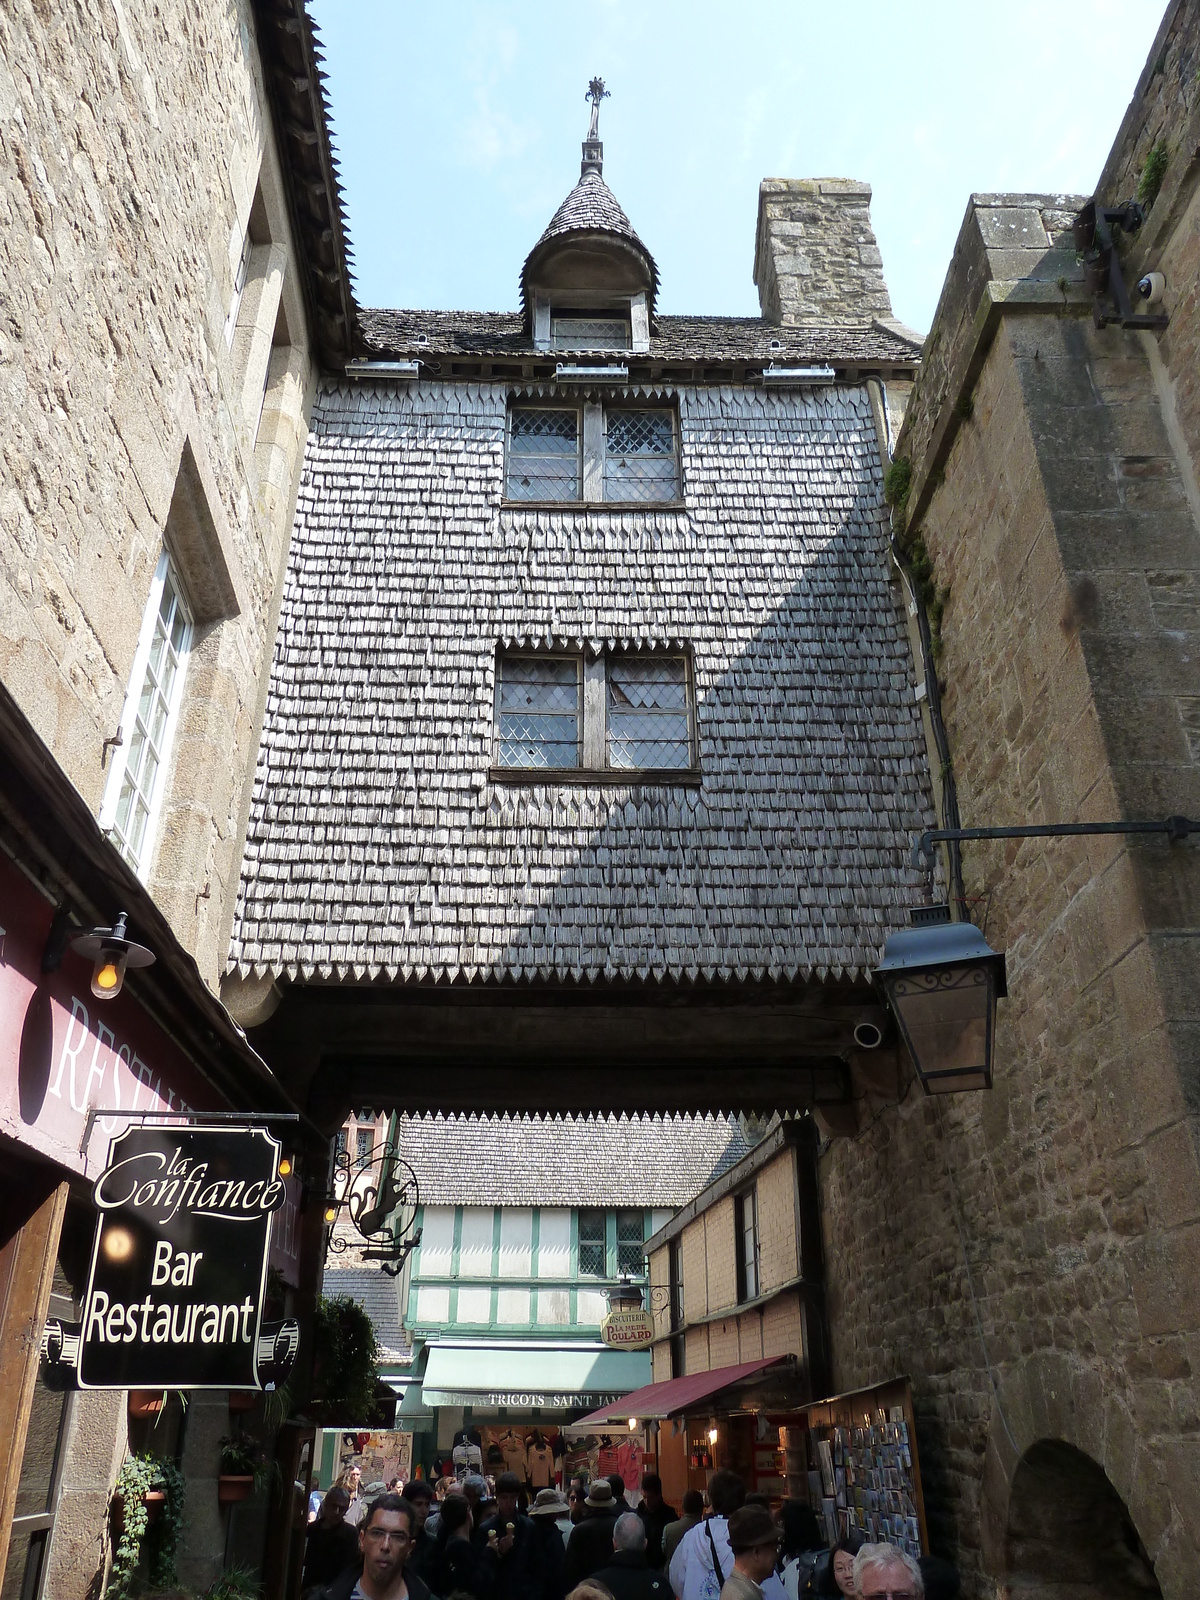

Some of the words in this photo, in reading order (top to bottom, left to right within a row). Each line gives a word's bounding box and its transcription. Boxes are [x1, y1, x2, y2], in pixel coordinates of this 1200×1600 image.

[166, 1146, 194, 1176] la
[94, 1152, 282, 1225] Confiance
[151, 1240, 204, 1286] Bar
[86, 1290, 254, 1344] Restaurant
[609, 1313, 646, 1324] BISCUITERIE
[615, 1324, 624, 1332] LA
[606, 1325, 652, 1342] POULARD
[488, 1393, 545, 1406] TRICOTS
[553, 1394, 592, 1407] SAINT
